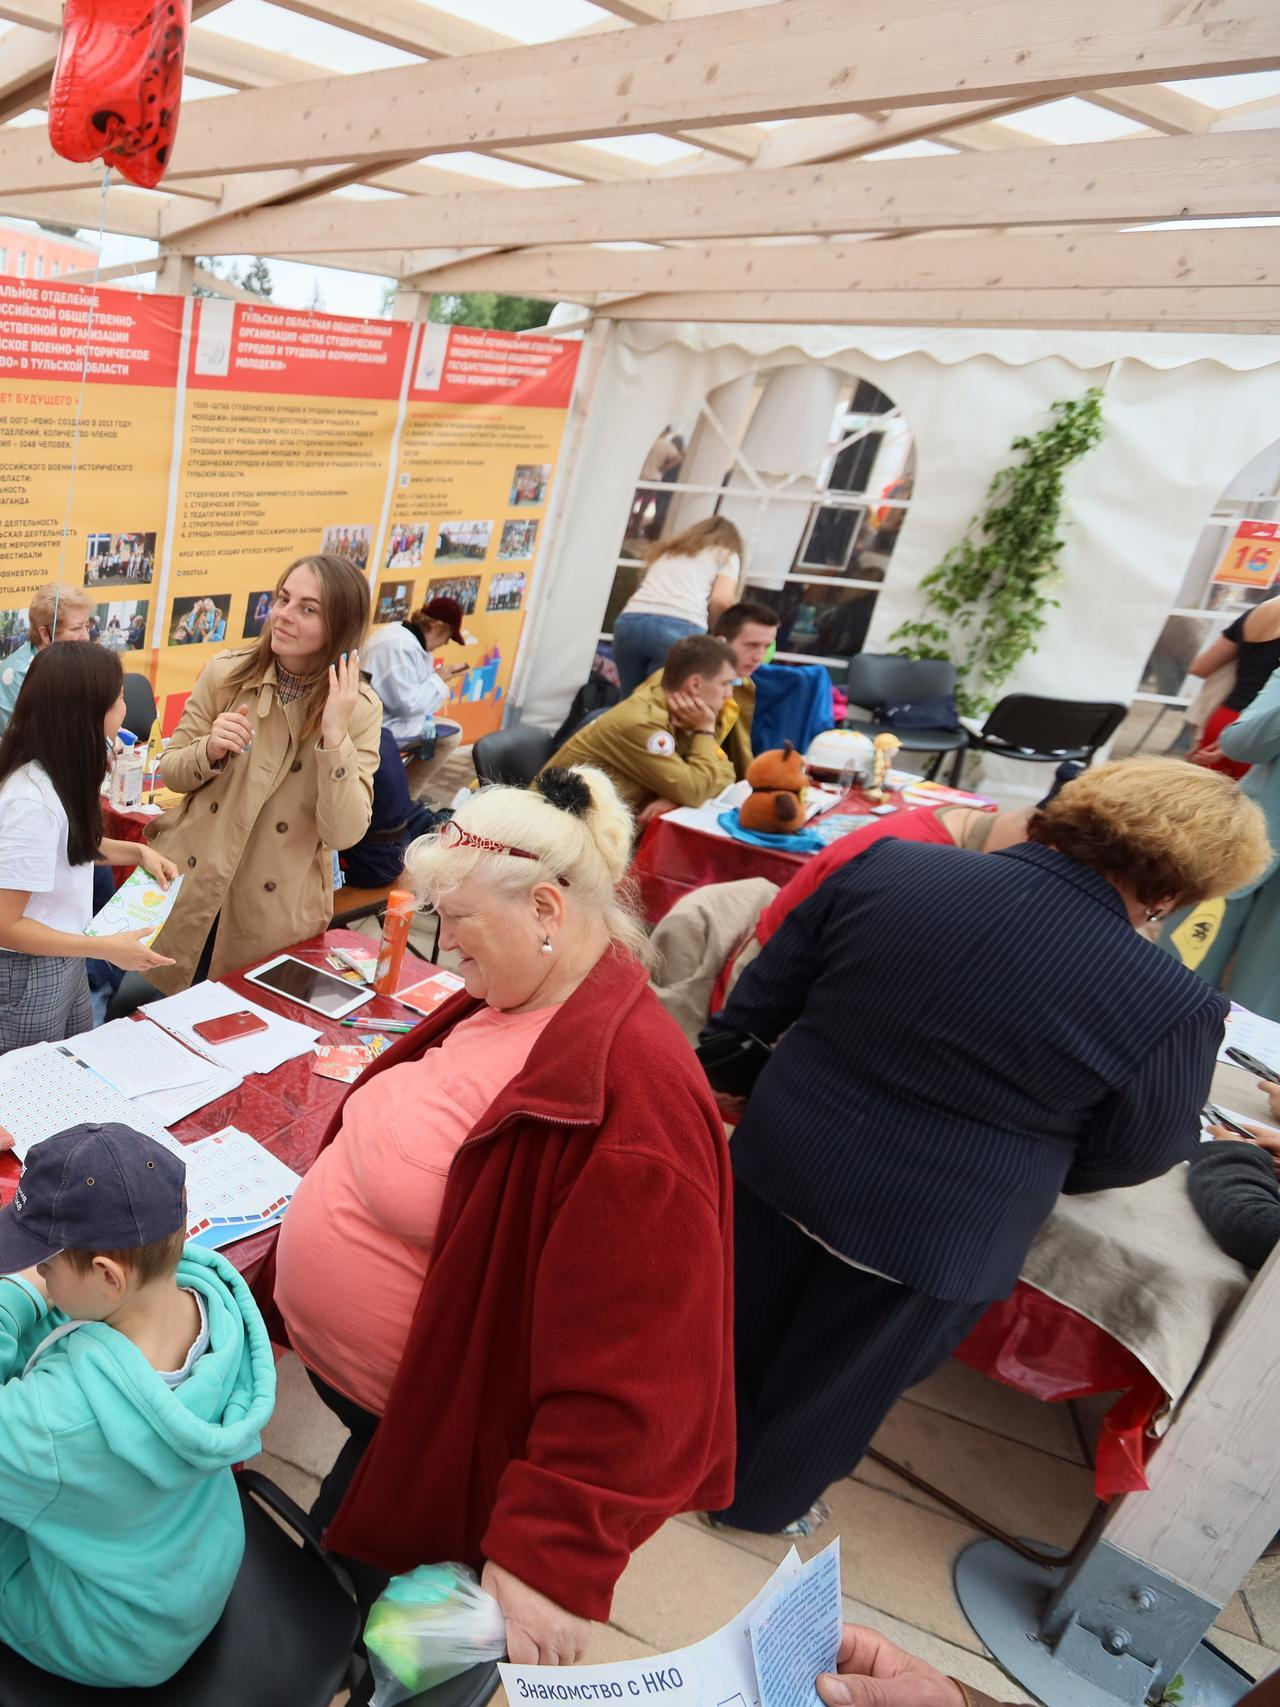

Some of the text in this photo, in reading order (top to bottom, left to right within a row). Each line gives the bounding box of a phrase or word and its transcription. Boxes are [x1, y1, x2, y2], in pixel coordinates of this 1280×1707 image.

[41, 290, 100, 308] ОТДЕЛЕНИЕ
[21, 357, 28, 369] В
[30, 356, 83, 372] ТУЛЬСКОЙ
[85, 361, 129, 375] ОБЛАСТИ
[16, 393, 72, 407] БУДУЩЕГО
[516, 1666, 684, 1701] Знакомство с НКО
